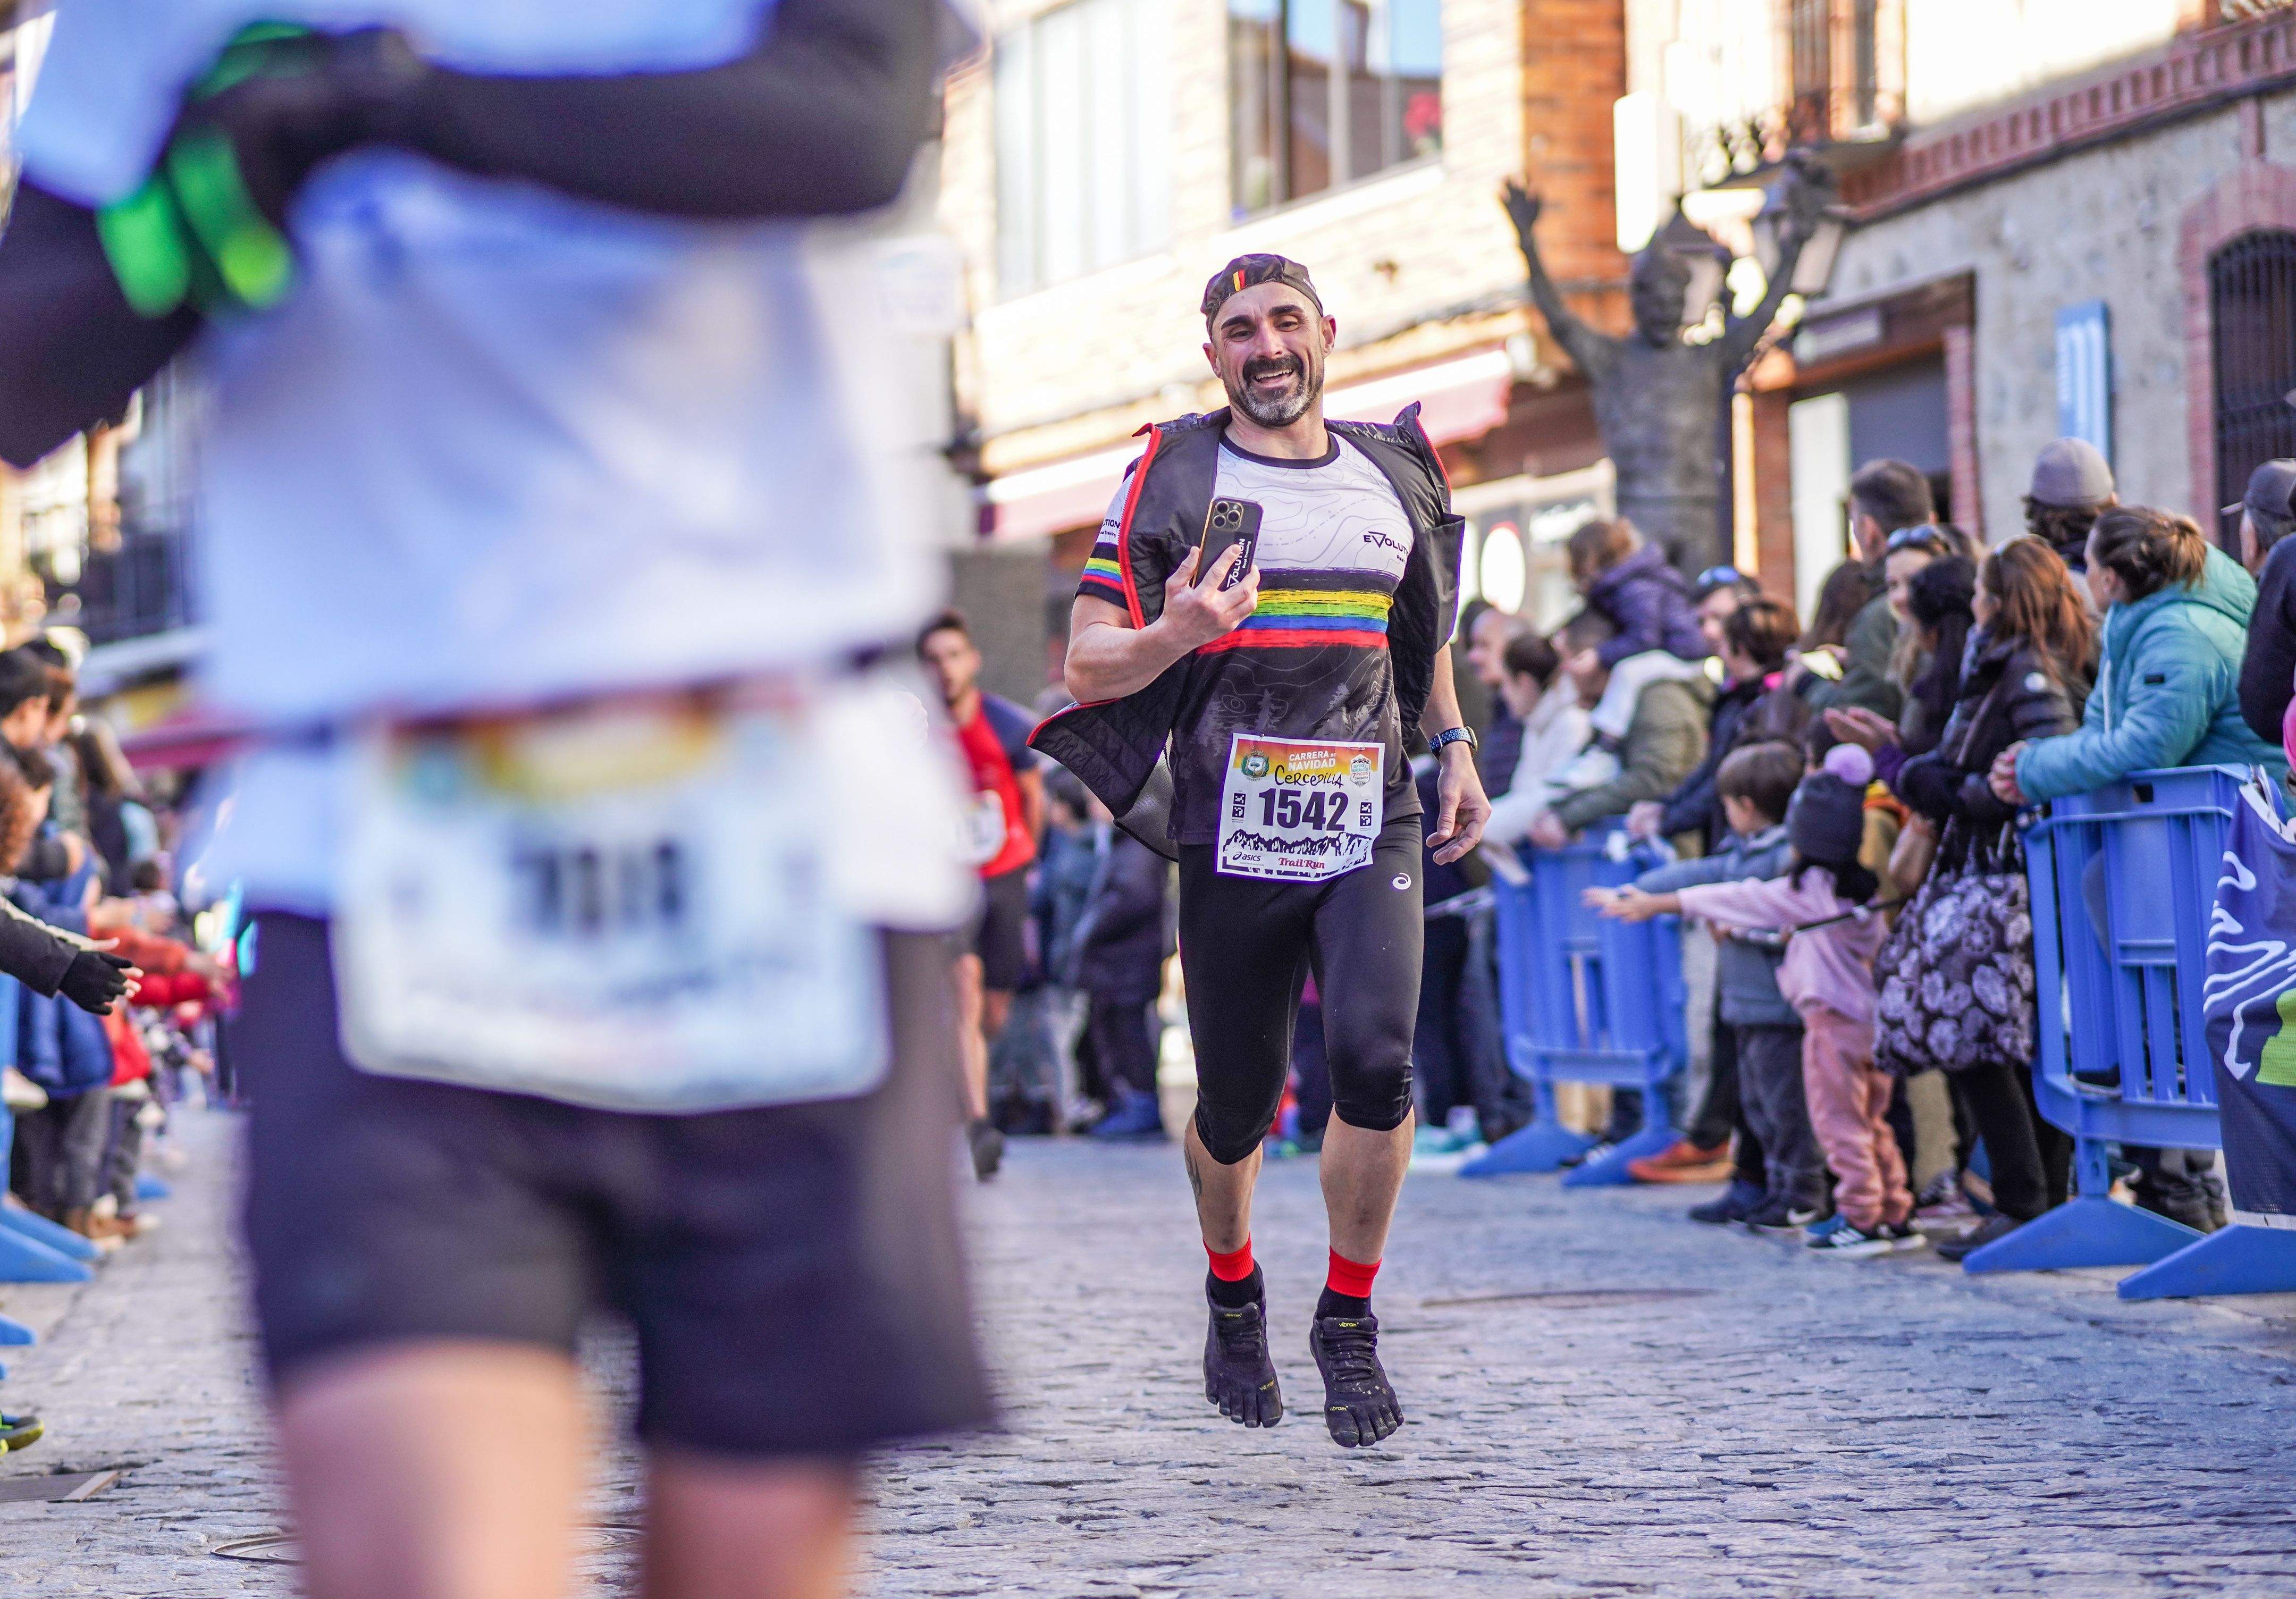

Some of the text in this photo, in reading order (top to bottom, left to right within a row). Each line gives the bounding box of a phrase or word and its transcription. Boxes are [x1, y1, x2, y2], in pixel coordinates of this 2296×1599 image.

[1289, 750, 1329, 761] CARRERA
[1288, 758, 1336, 771] NAVIDAD
[1259, 788, 1349, 831] 1542
[1241, 853, 1261, 862] asics
[1278, 857, 1325, 869] Trail Run
